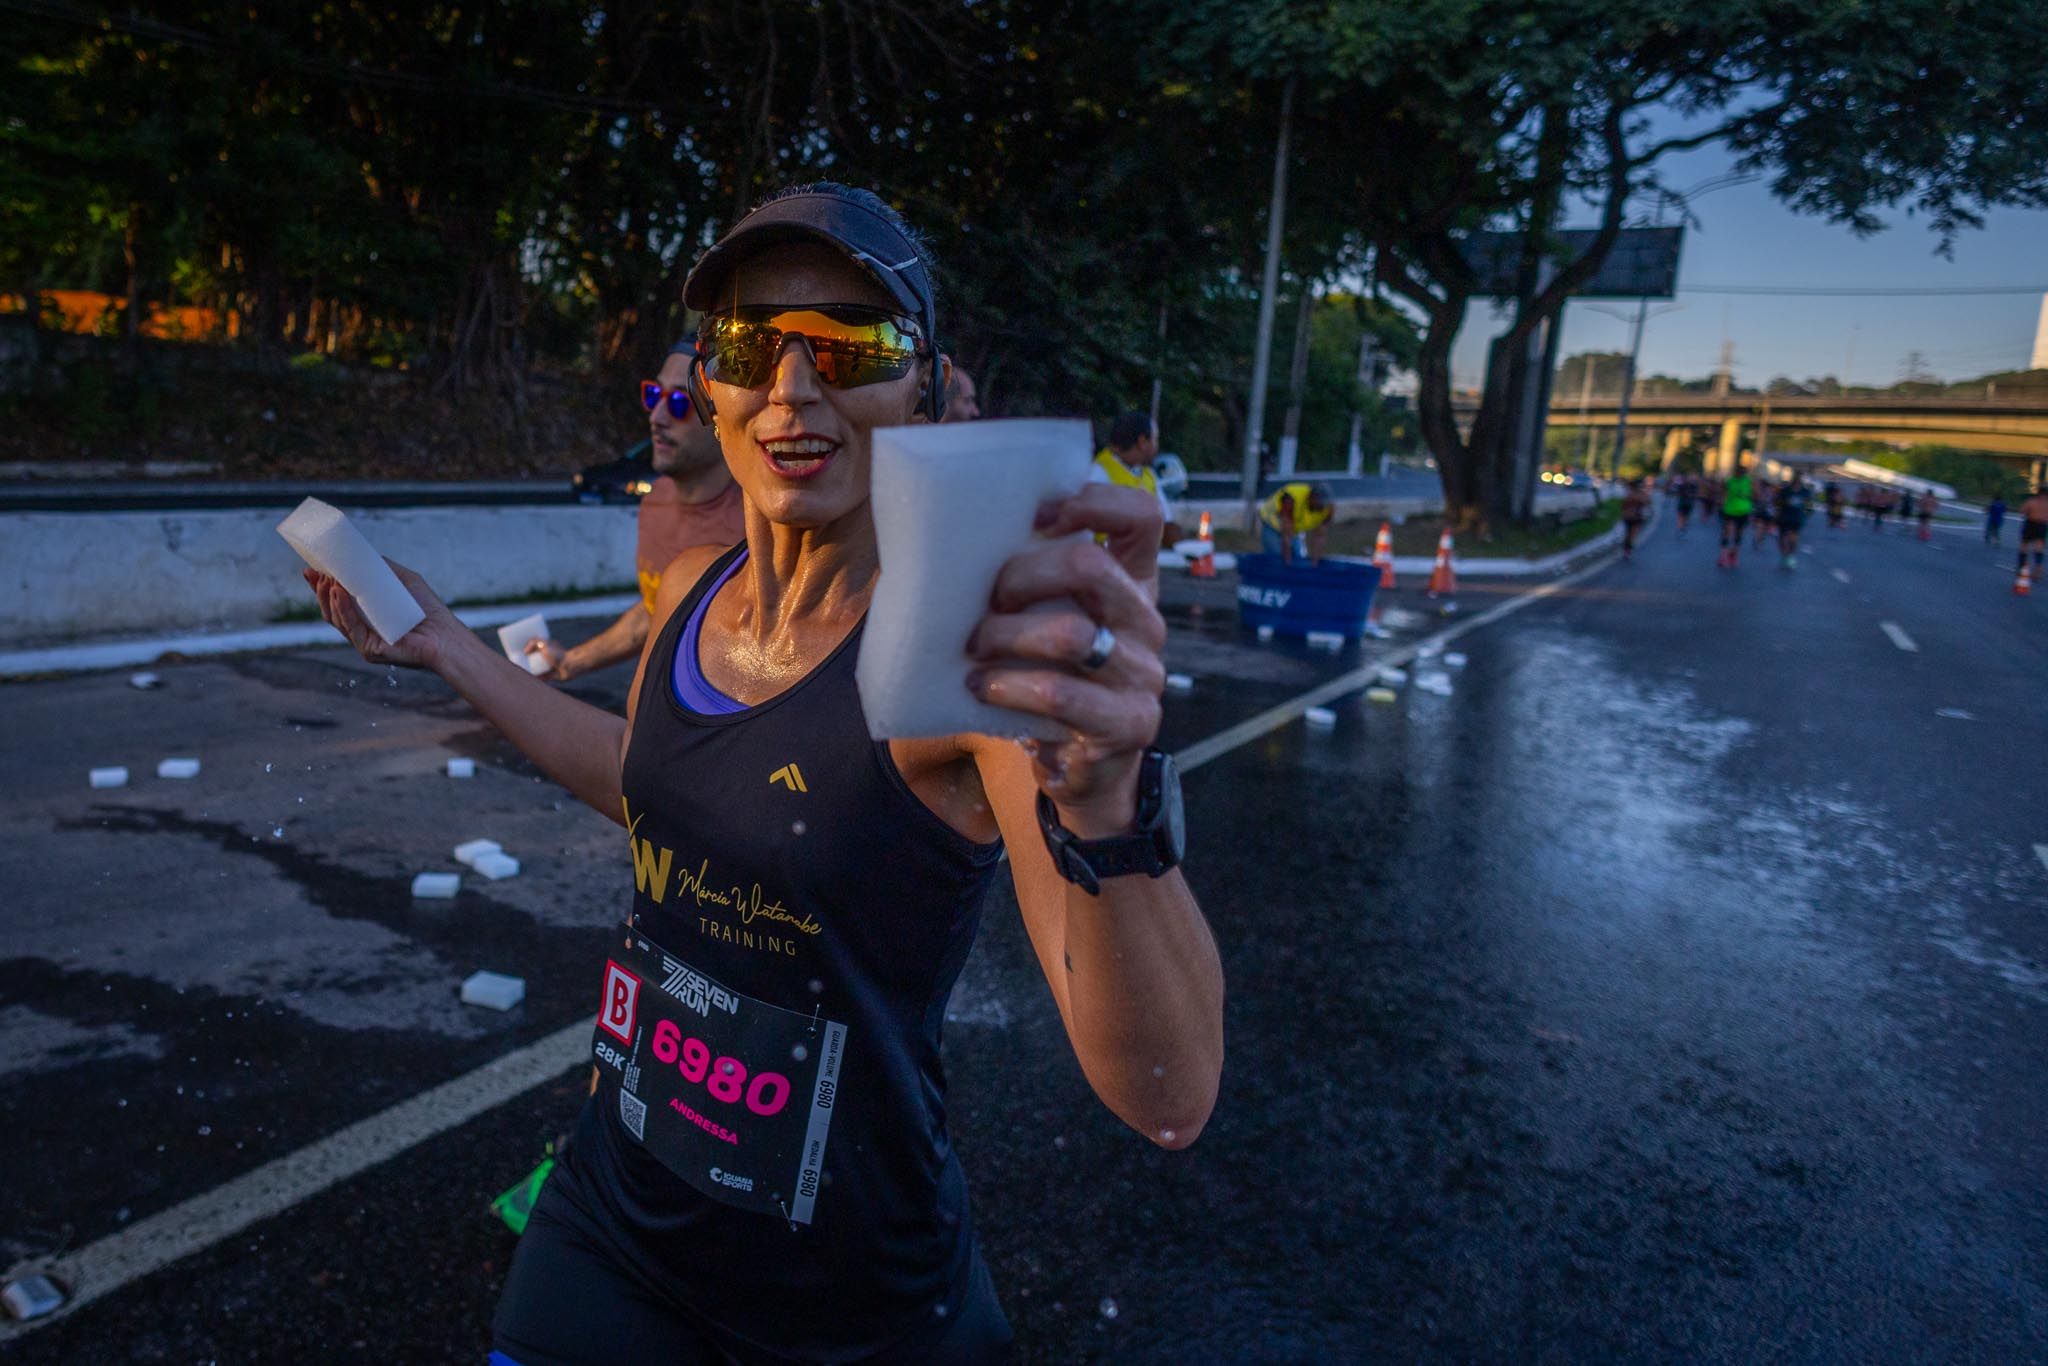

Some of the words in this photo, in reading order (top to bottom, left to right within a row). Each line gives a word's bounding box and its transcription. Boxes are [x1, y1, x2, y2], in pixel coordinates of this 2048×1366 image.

[731, 883, 823, 935] Watanabe
[699, 917, 796, 956] TRAINING
[611, 976, 630, 1026] B
[675, 986, 710, 1017] RUN
[686, 971, 739, 1015] SEVEN
[595, 1042, 626, 1071] 28K
[652, 1019, 791, 1116] 6980
[816, 1080, 835, 1109] 6980
[669, 1098, 738, 1145] ANDRESSA
[800, 1169, 818, 1198] 6980
